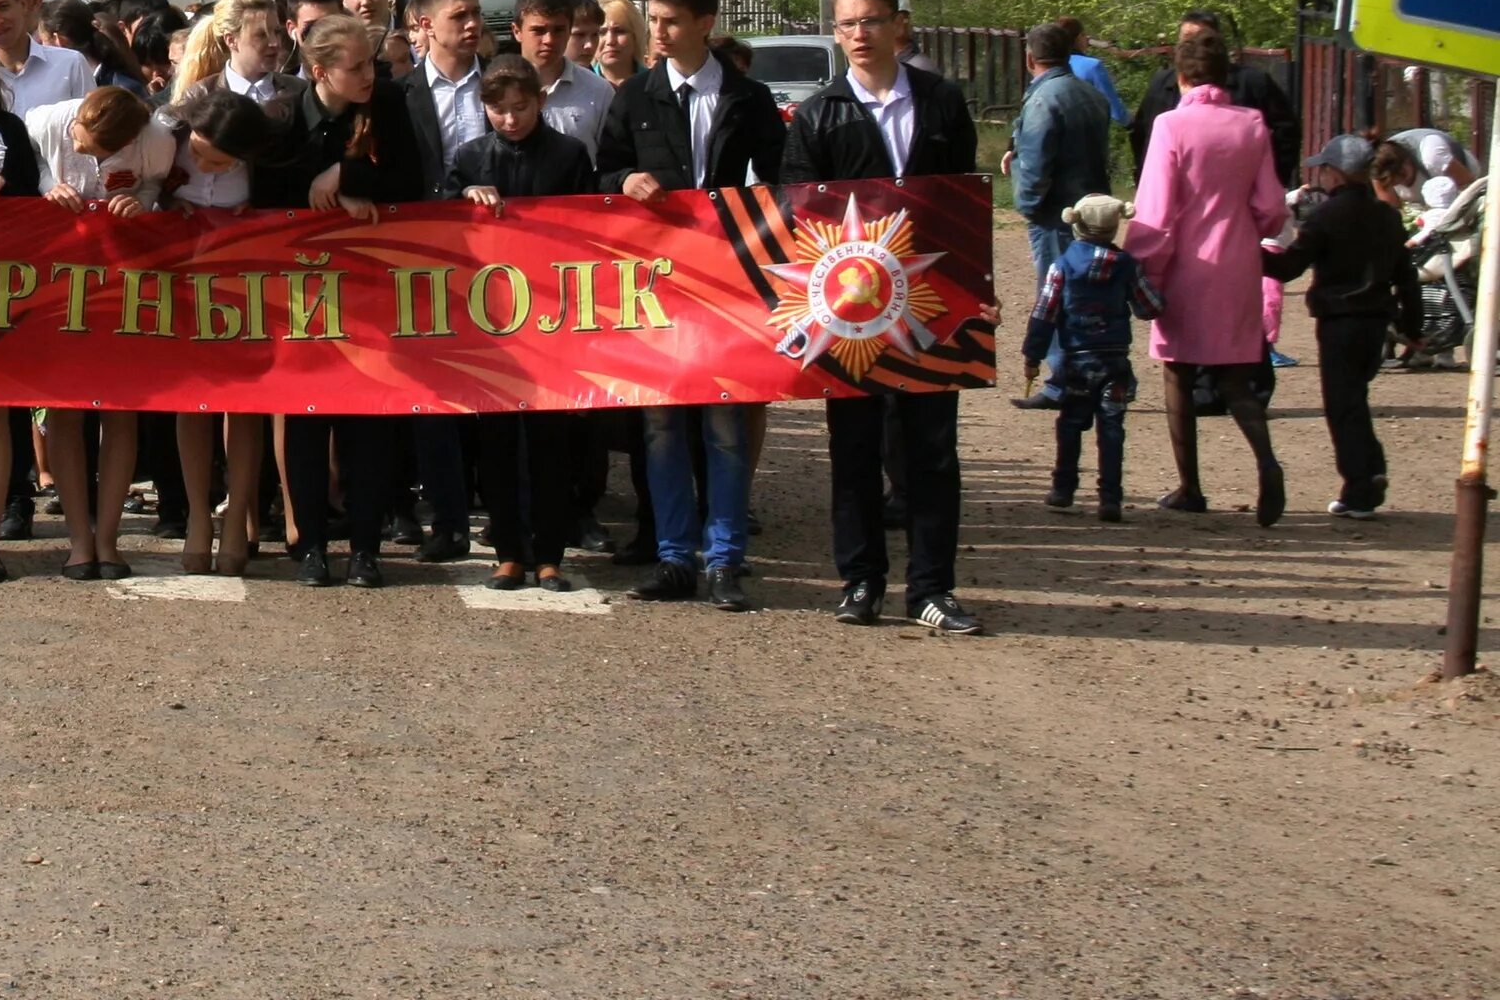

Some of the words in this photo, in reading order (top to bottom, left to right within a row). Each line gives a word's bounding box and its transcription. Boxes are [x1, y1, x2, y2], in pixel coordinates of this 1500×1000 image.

[388, 258, 674, 336] ПОЛК
[812, 245, 887, 325] ОТЕЧЕСТВЕННАЯ
[884, 269, 905, 322] ВОЙНА
